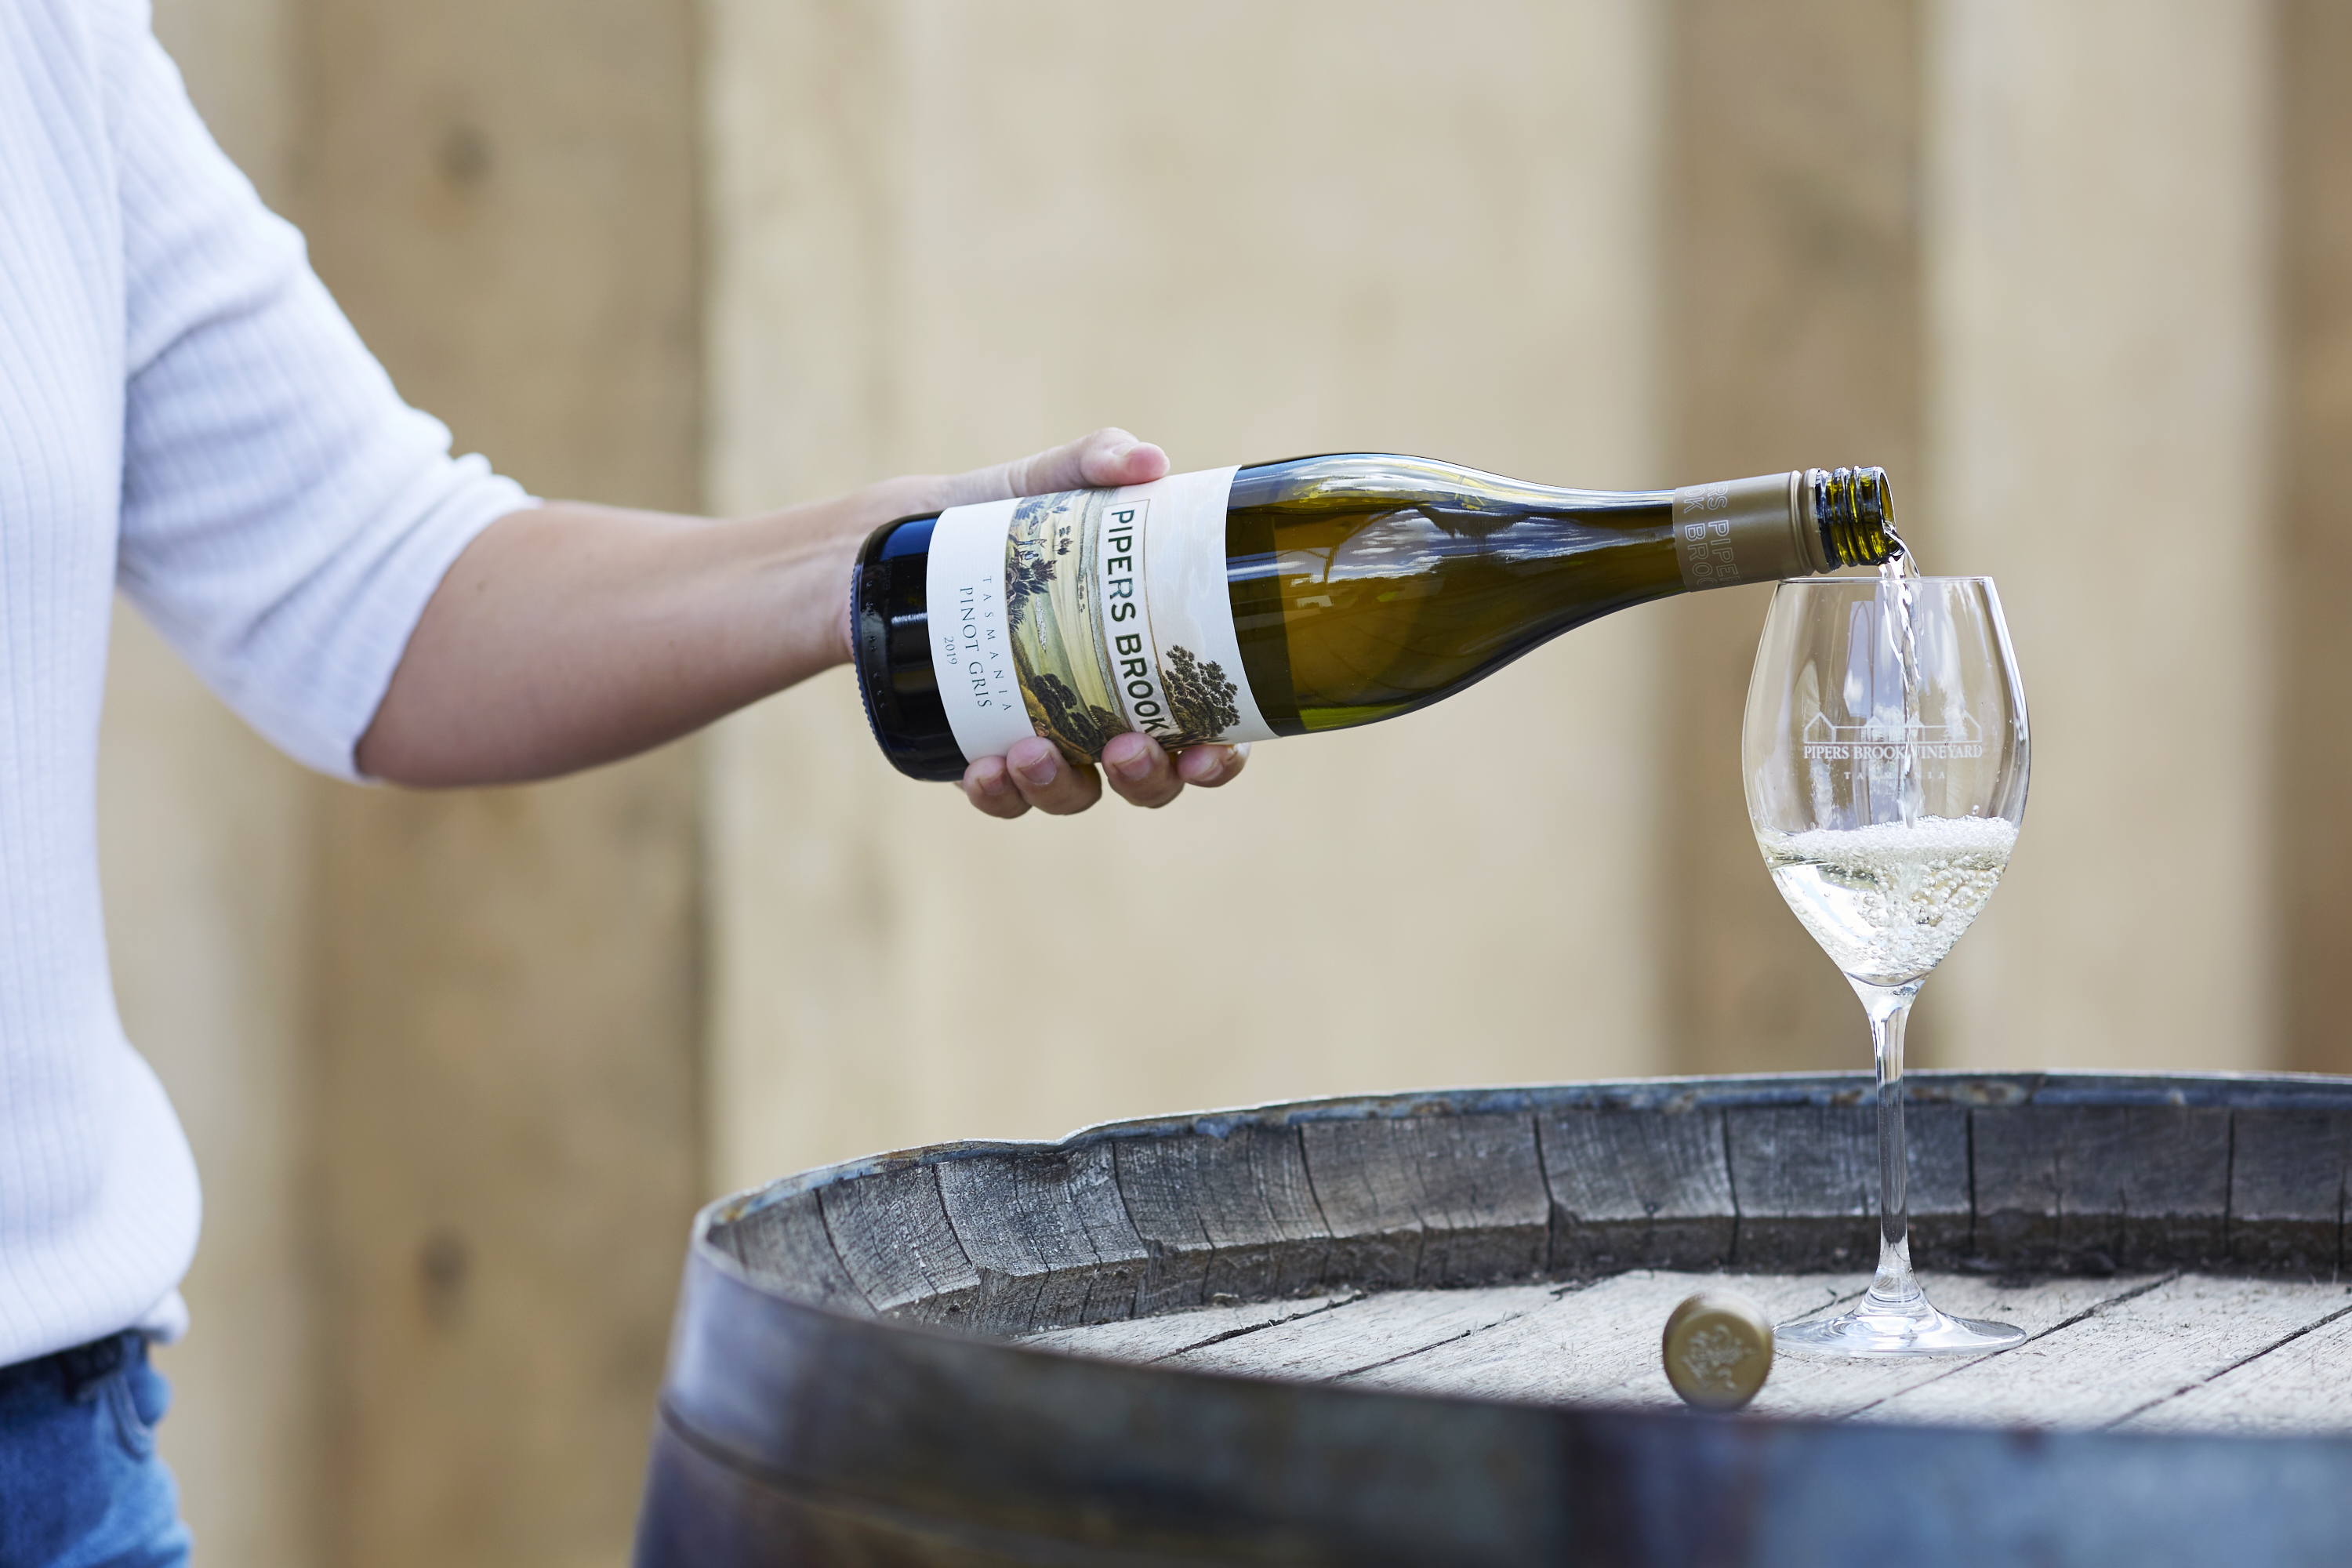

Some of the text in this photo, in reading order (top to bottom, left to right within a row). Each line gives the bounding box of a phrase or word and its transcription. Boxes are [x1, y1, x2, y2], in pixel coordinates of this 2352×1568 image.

[944, 636, 958, 665] 2019
[960, 586, 993, 708] PINOT GRIS
[982, 575, 1012, 711] TASMANIA
[1107, 509, 1171, 734] PIPERS BROOK
[1803, 746, 1849, 760] PIPERS
[1853, 745, 1906, 760] BROOK
[1843, 771, 1945, 780] TAMANIA
